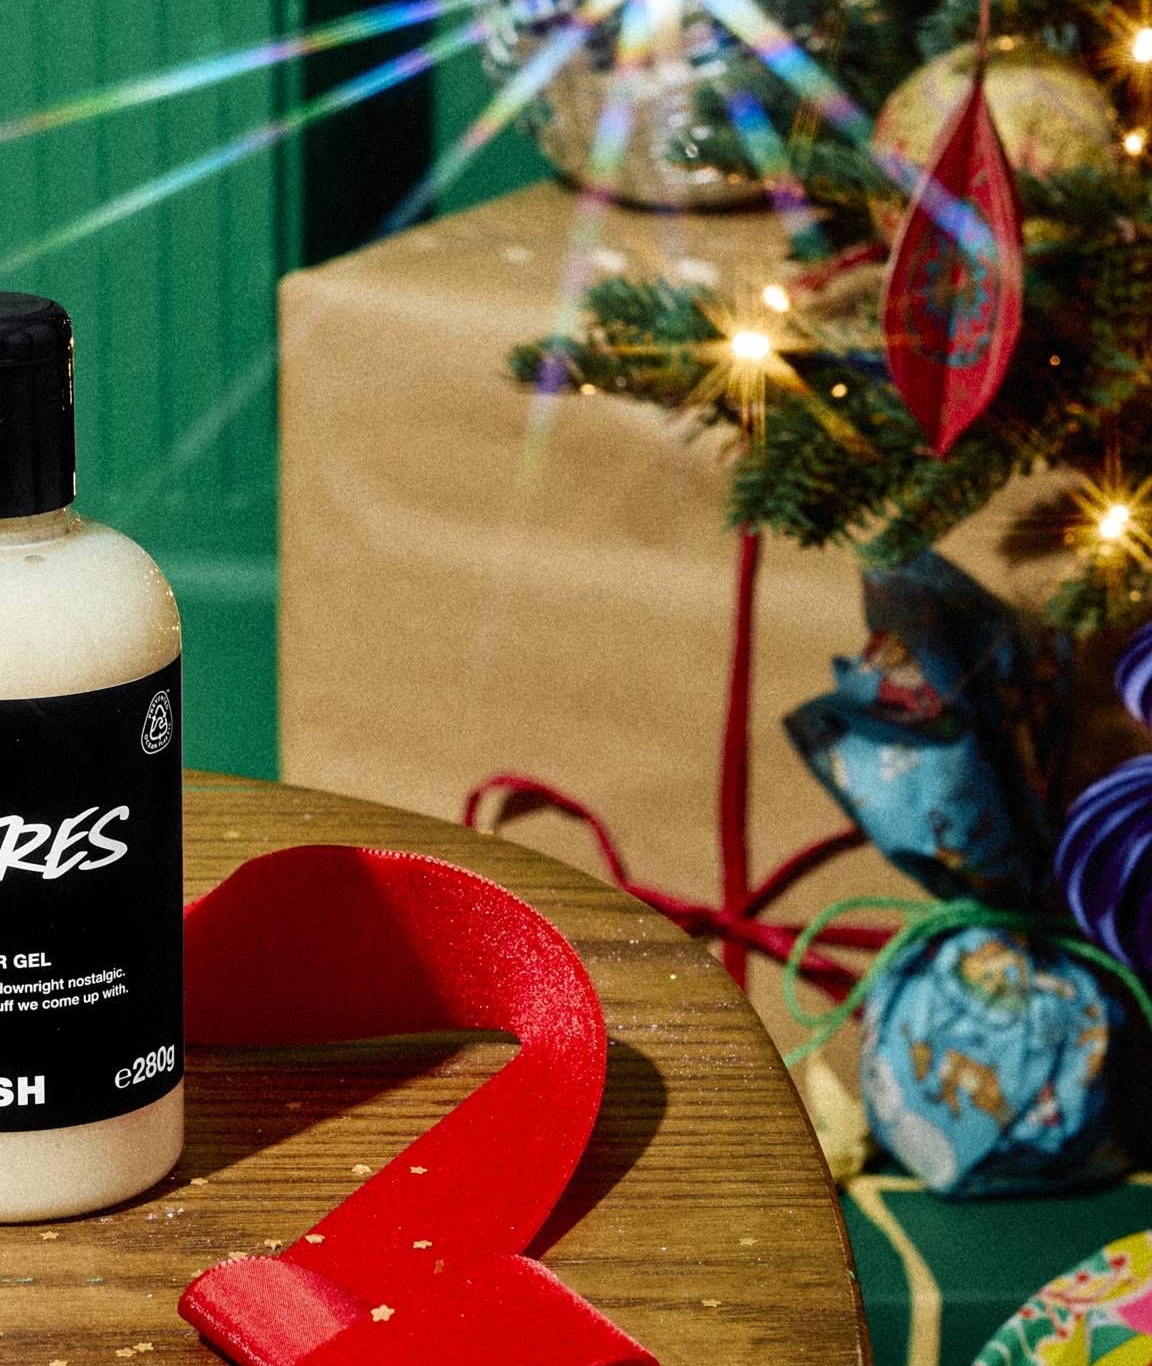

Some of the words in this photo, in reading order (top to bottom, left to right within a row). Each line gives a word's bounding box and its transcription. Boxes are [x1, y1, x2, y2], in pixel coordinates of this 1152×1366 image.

[13, 952, 52, 969] GEL
[68, 967, 126, 989] nostalgic.
[17, 1000, 38, 1011] we
[42, 995, 80, 1010] come
[83, 991, 99, 1005] up
[102, 983, 128, 999] with.
